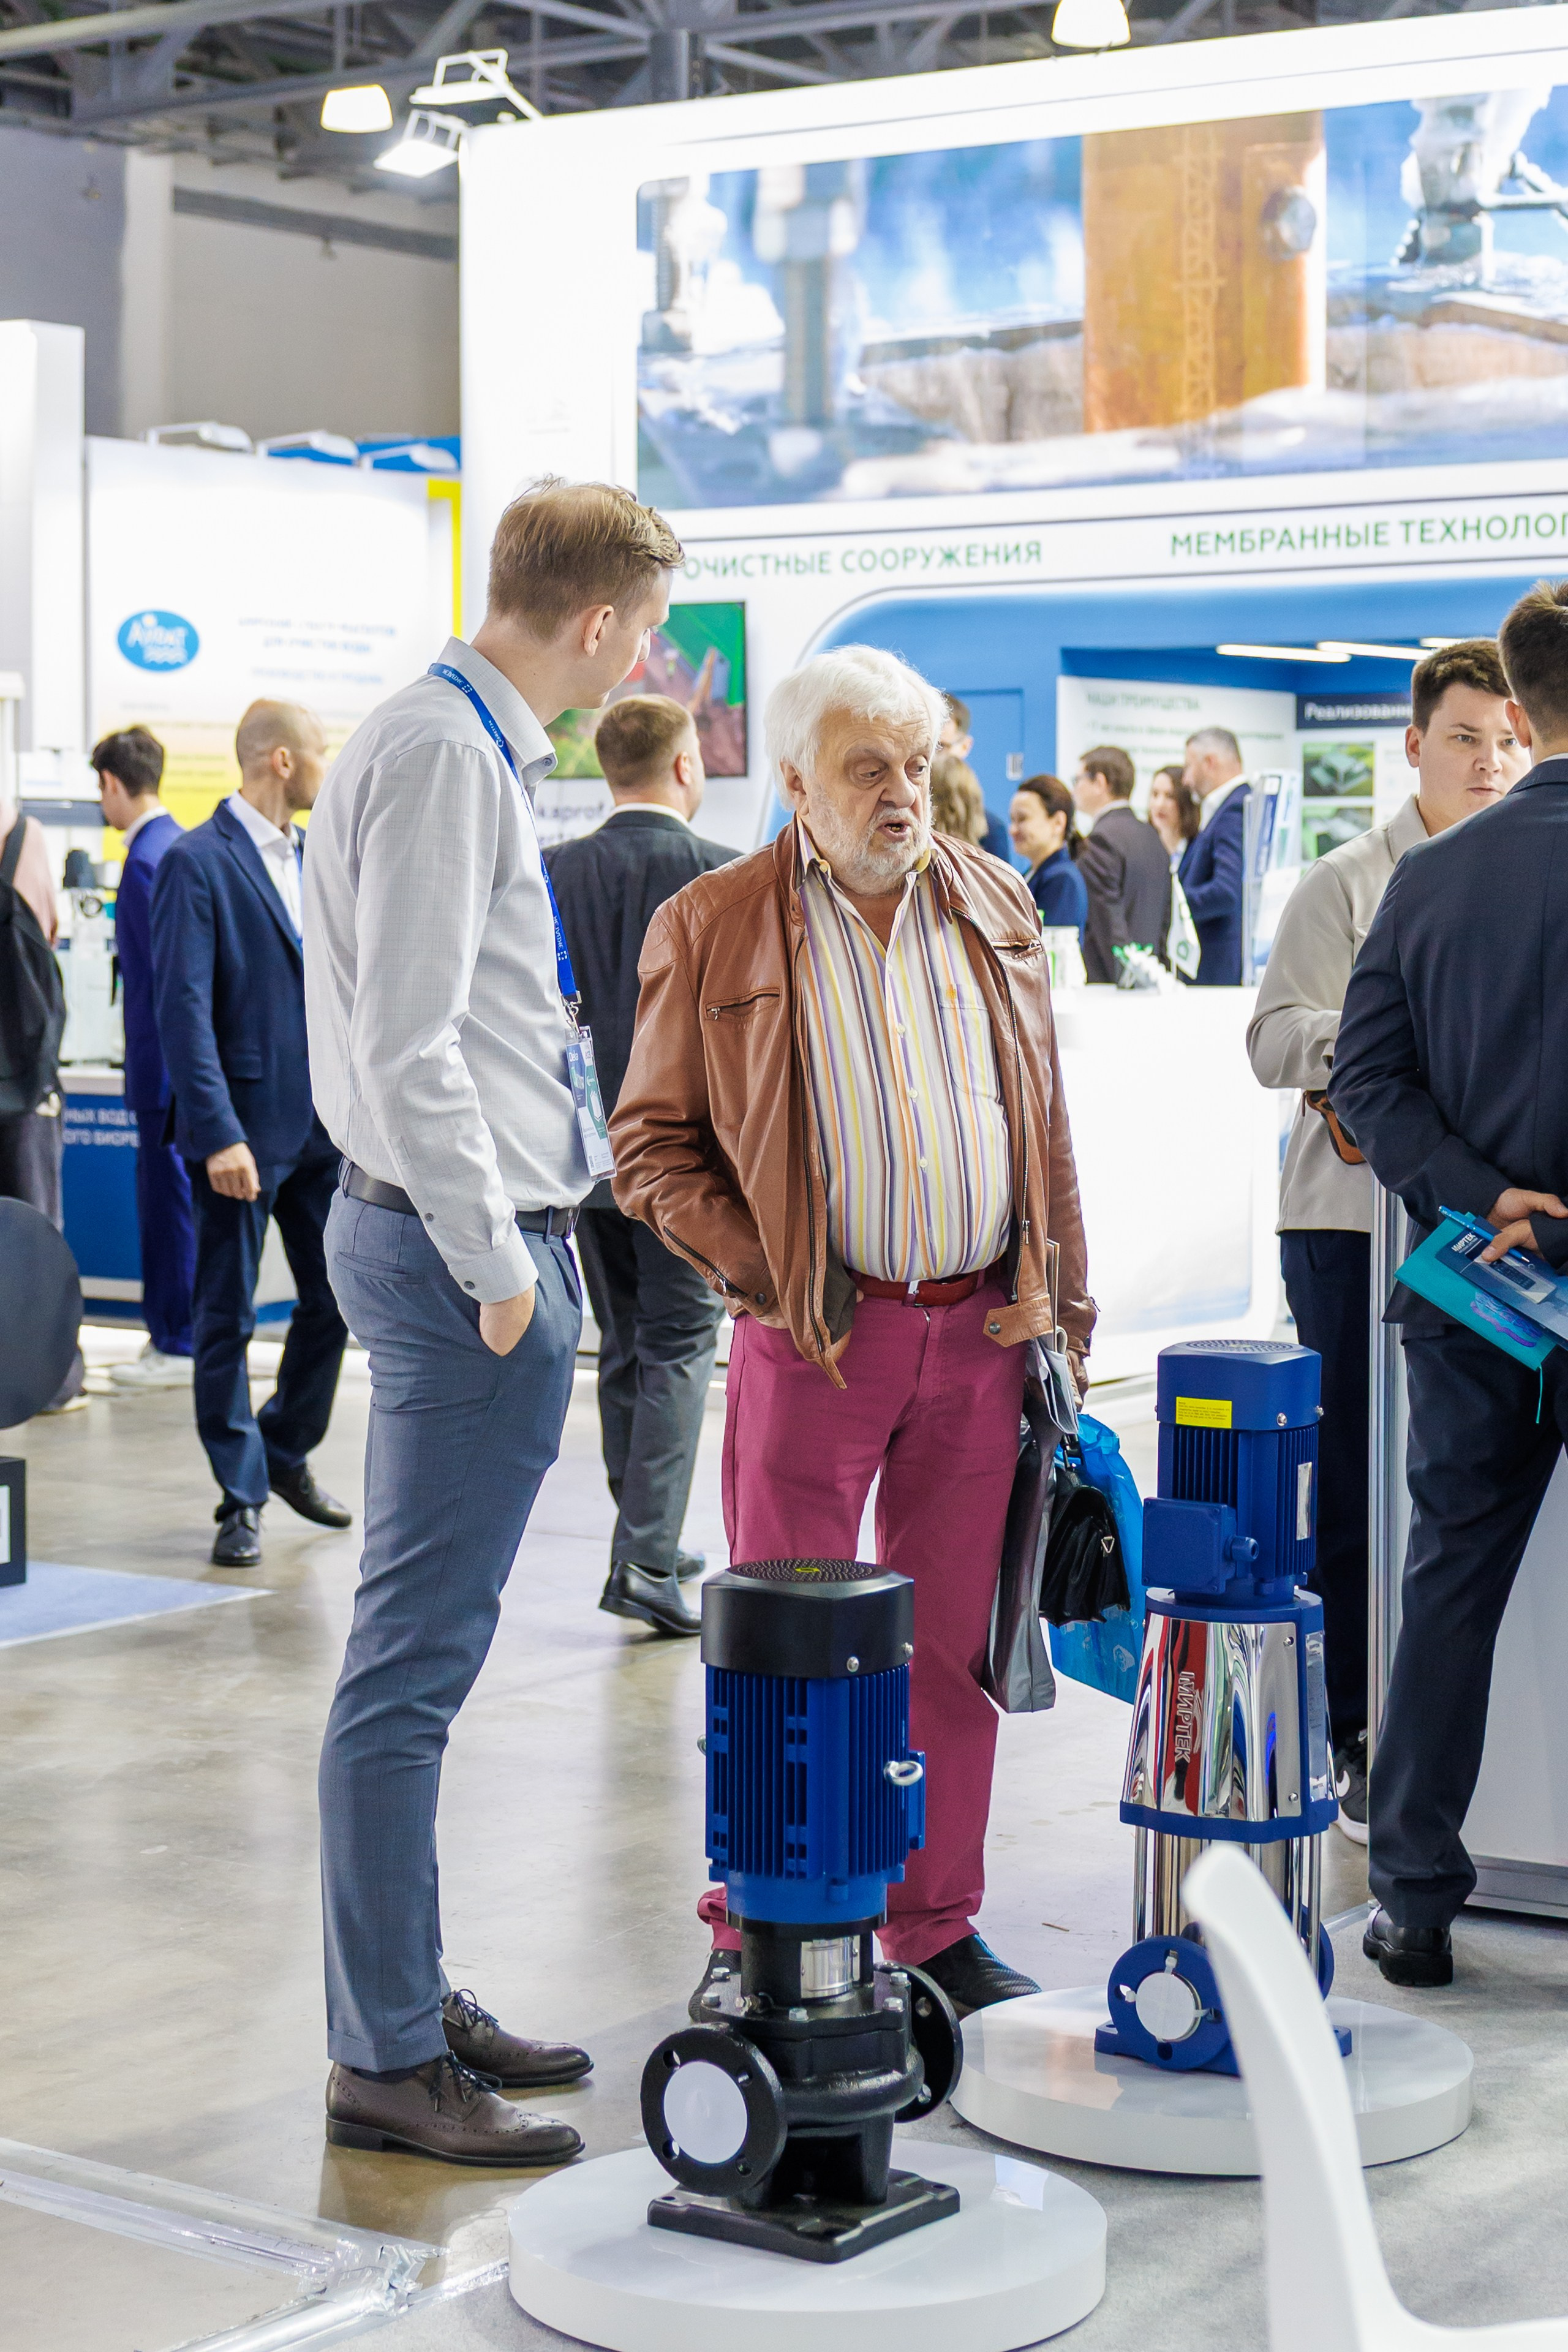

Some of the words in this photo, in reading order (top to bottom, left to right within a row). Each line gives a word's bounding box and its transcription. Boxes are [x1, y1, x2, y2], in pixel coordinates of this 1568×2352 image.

[1170, 521, 1390, 557] МЕМБРАННЫЕ
[683, 551, 831, 581] ОЧИСТНЫЕ
[841, 540, 1042, 573] СООРУЖЕНИЯ
[1174, 1671, 1196, 1763] МИРТЕК
